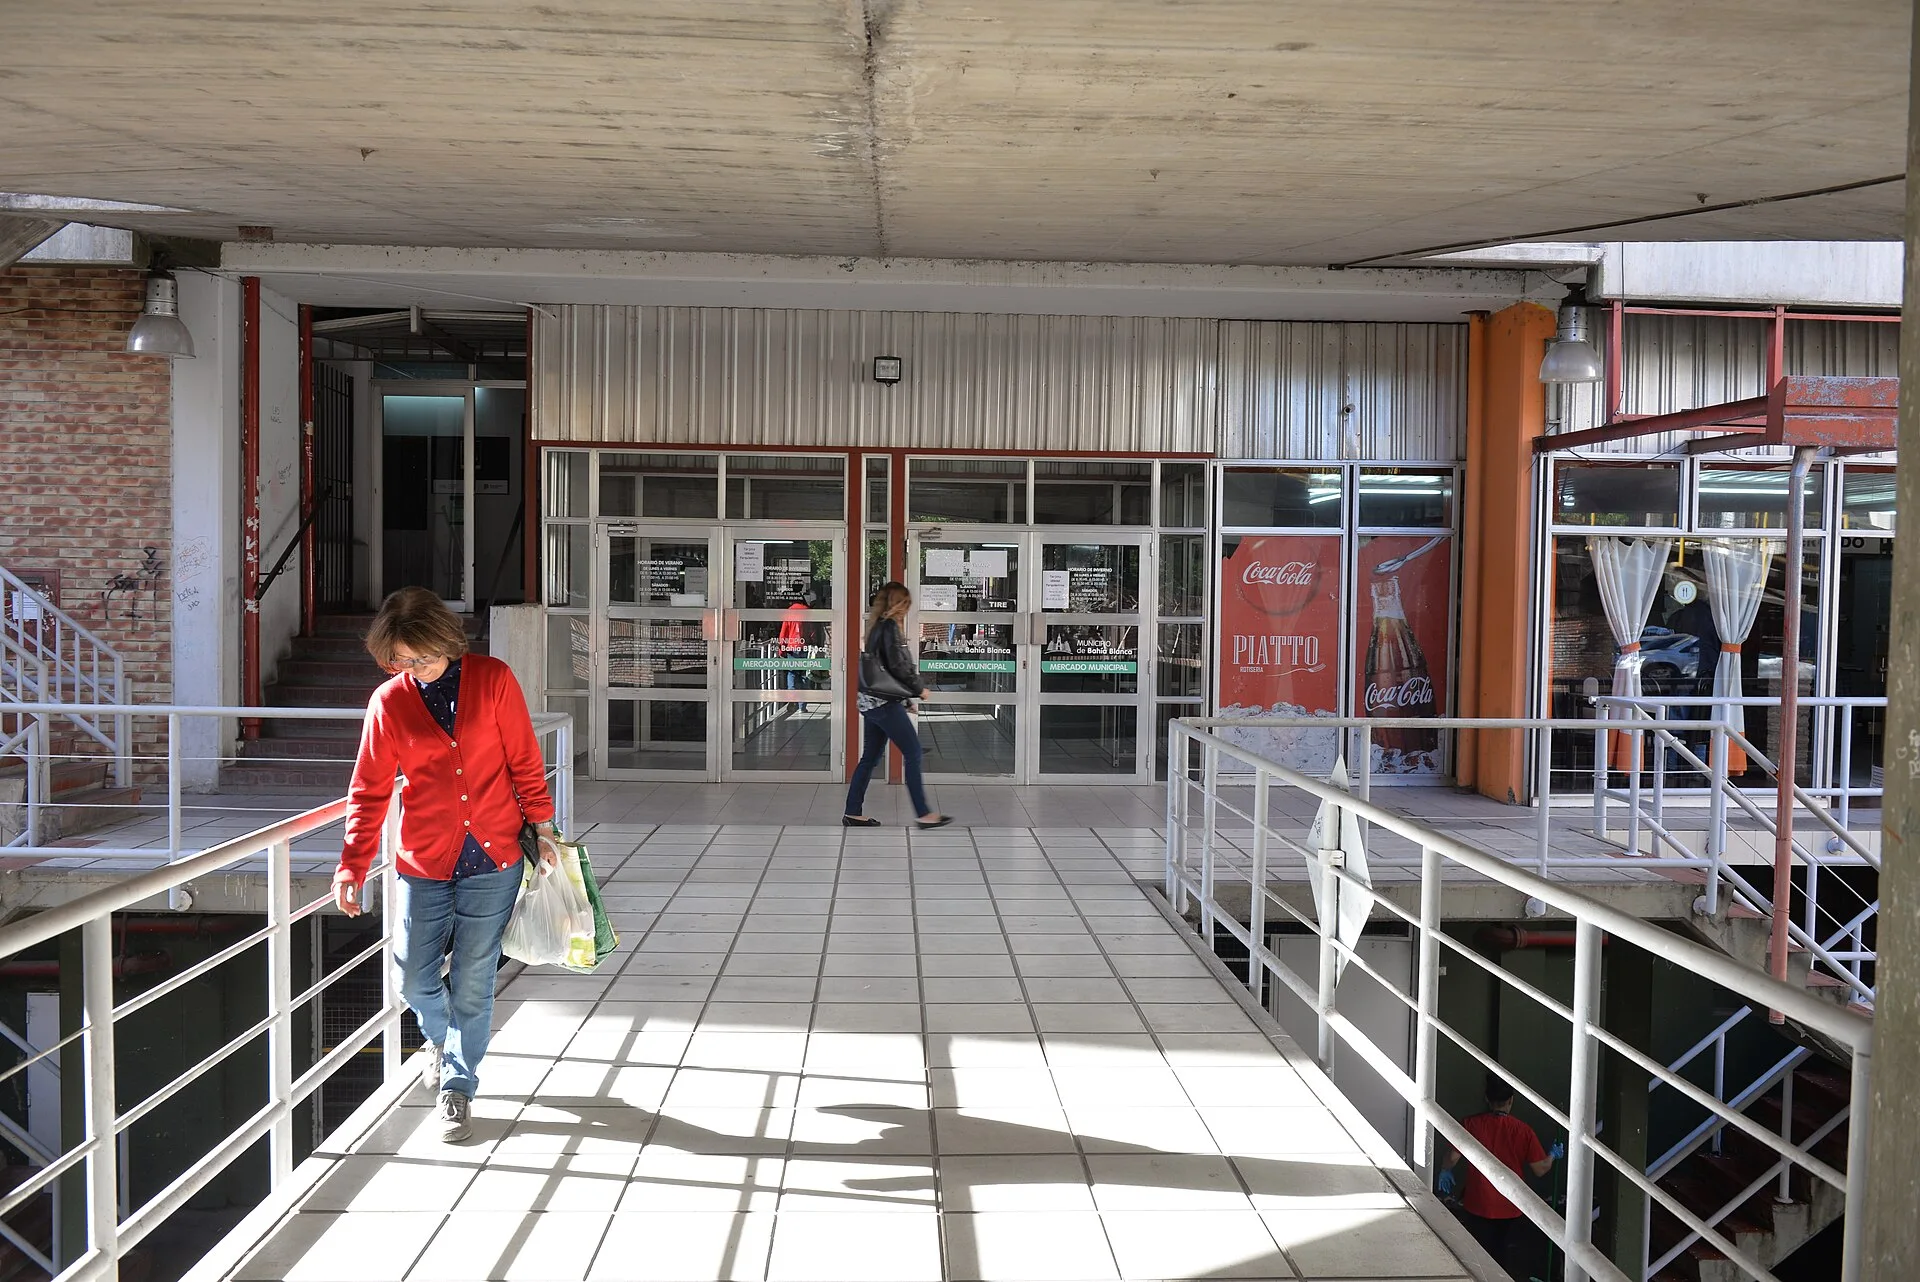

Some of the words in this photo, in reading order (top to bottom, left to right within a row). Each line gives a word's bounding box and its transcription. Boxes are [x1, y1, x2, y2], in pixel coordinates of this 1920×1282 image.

[1242, 561, 1316, 585] Coca-Cola
[965, 646, 985, 654] Bahía
[1233, 634, 1319, 666] PIATTO
[1365, 676, 1433, 712] Coca-Cola
